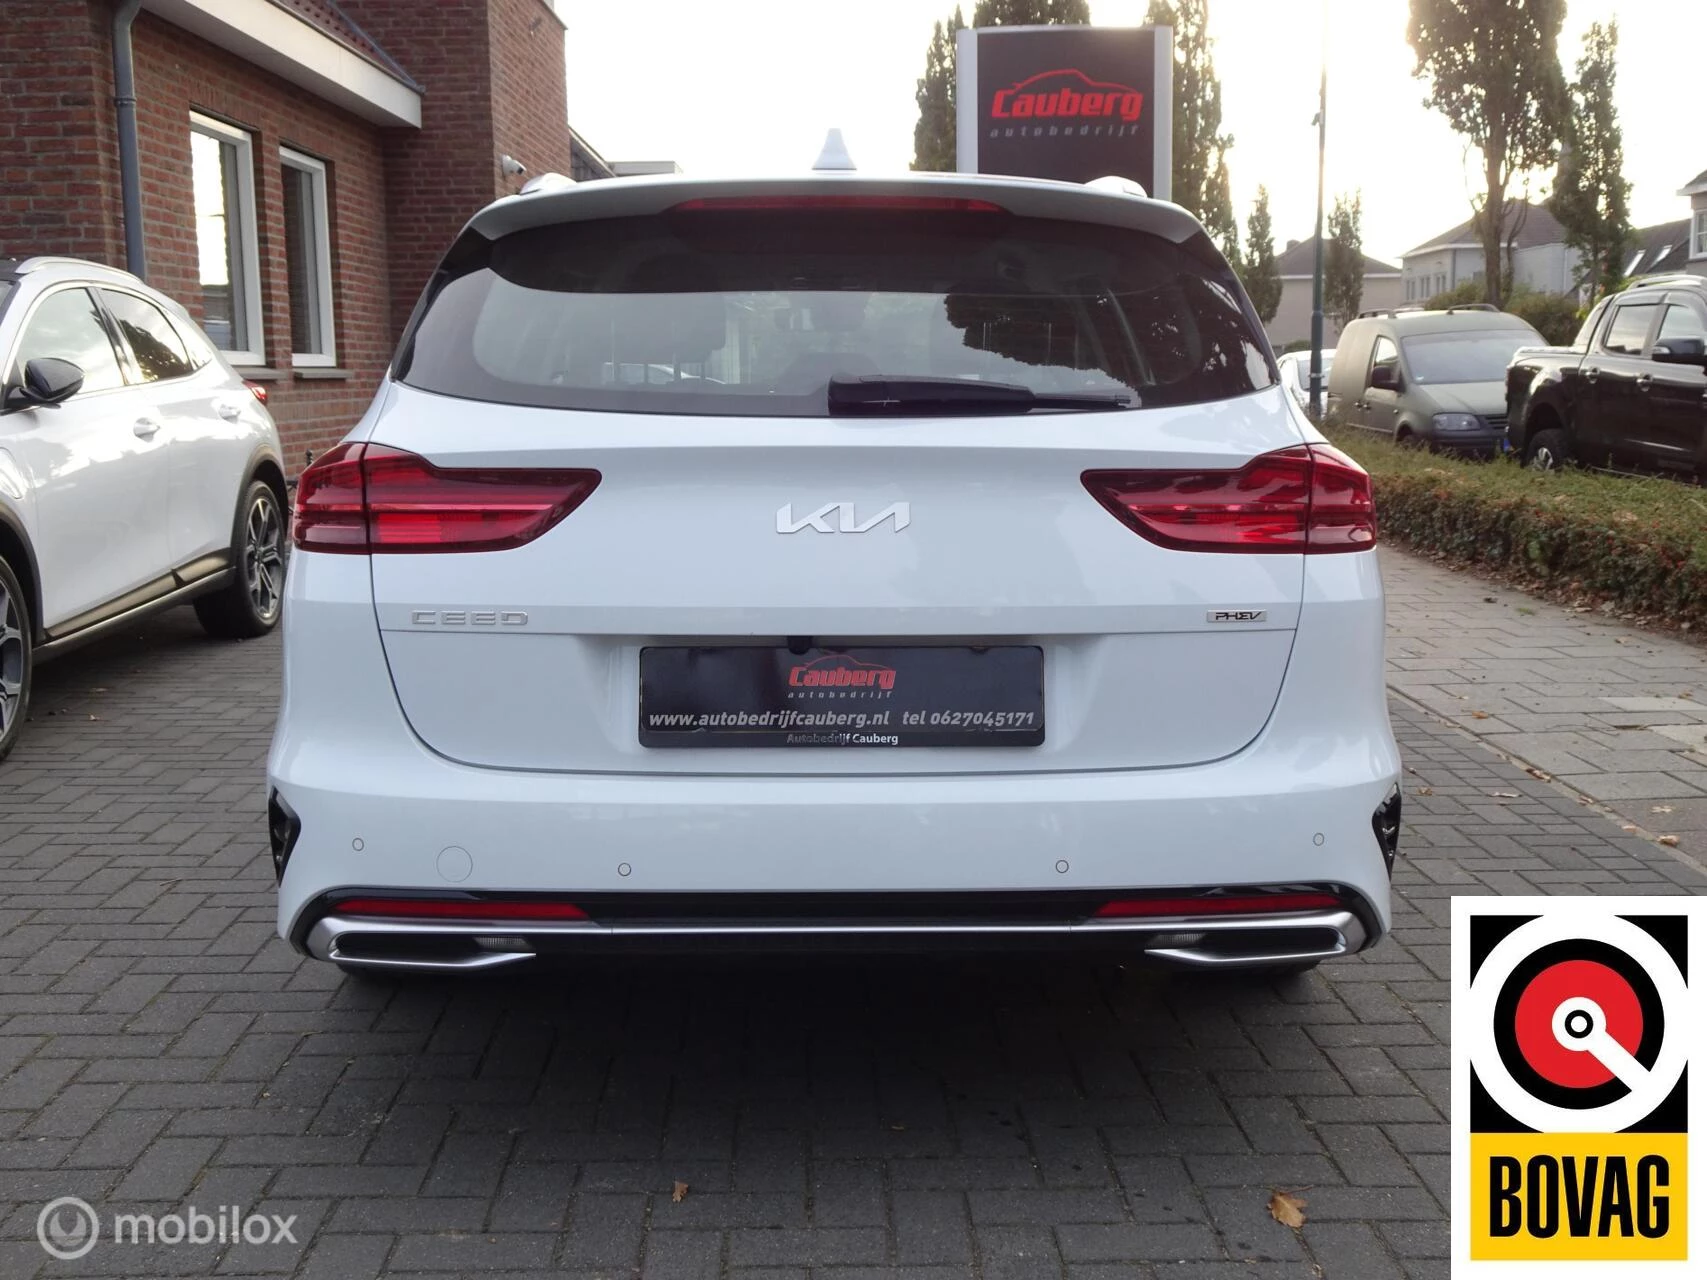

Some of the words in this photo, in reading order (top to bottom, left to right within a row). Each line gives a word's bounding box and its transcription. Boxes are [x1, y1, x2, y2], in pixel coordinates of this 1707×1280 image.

[991, 88, 1144, 121] Cauberg
[990, 124, 1138, 138] autobedrijf
[776, 502, 911, 534] KIA
[412, 610, 528, 626] CEED
[1215, 611, 1262, 621] PHEV
[788, 666, 896, 690] Cauberg
[787, 690, 893, 700] autobedrijf
[650, 710, 890, 729] www.autobedrijfcauberg.nl
[902, 710, 926, 726] tel
[930, 711, 1035, 727] 0627045171
[787, 733, 851, 745] Autobedrijf
[852, 733, 899, 746] Cauberg
